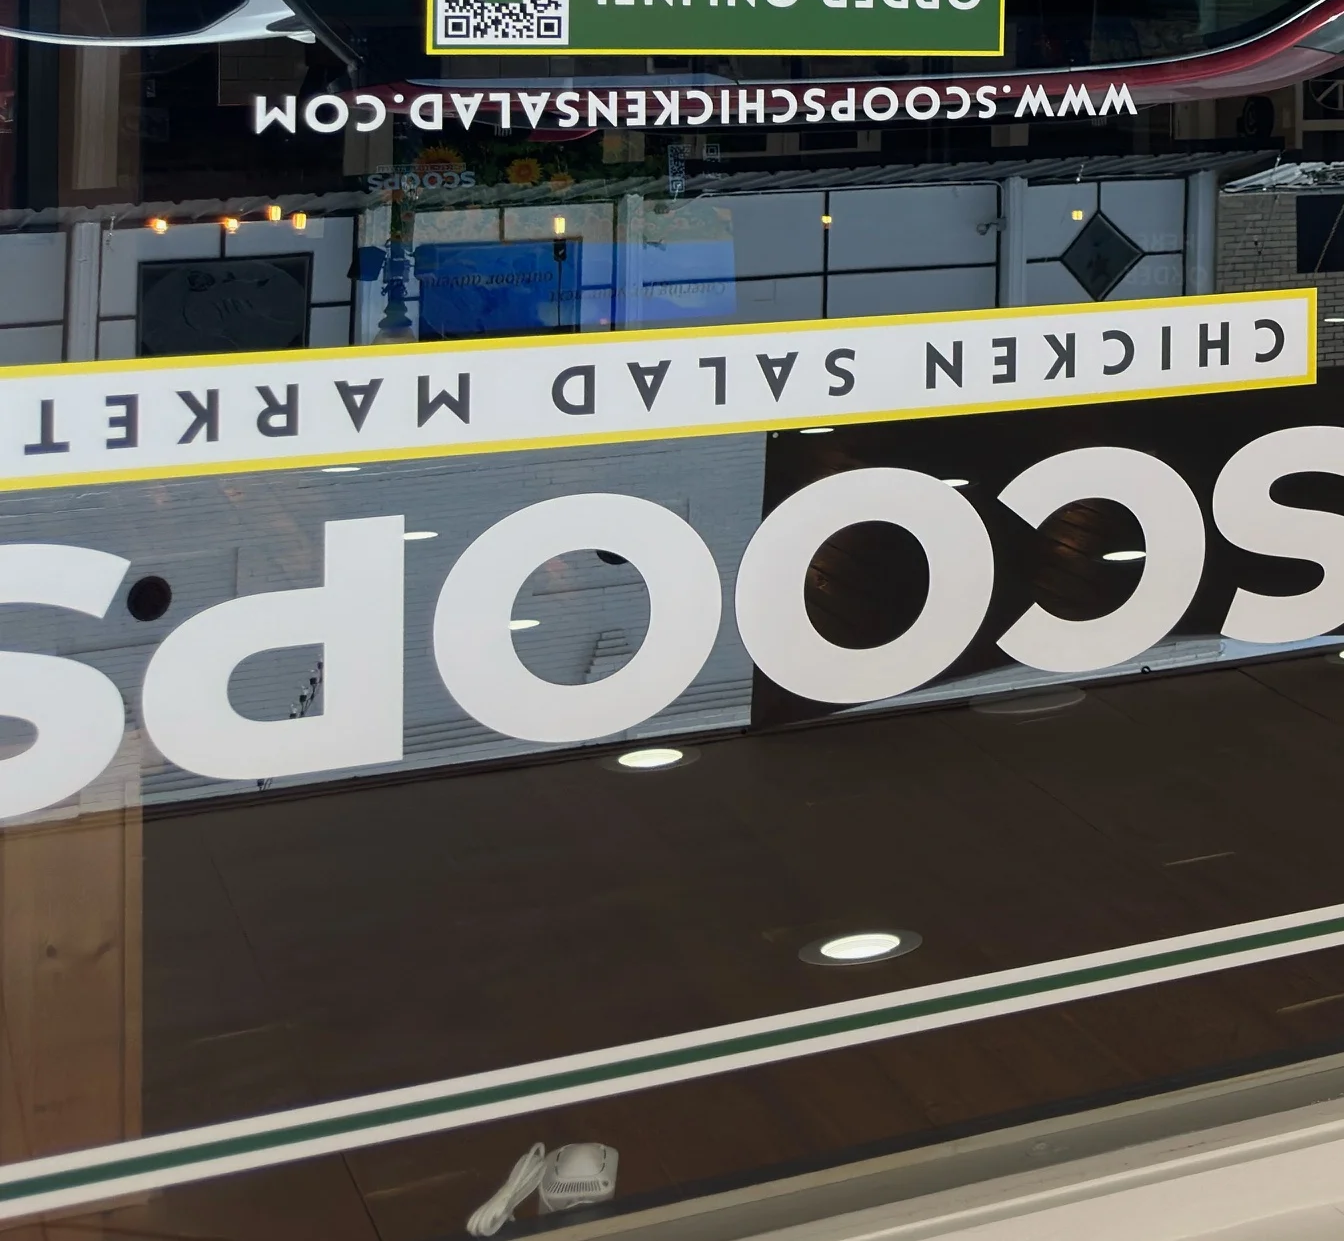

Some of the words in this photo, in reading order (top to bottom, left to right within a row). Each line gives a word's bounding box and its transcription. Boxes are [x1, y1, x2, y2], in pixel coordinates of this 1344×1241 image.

[251, 84, 1137, 134] WWW.SCOOPSCHICKENSALAD.COM
[367, 171, 476, 191] SCOOPS
[421, 273, 481, 291] adven
[551, 348, 856, 416] SALAD
[925, 318, 1285, 390] CHICKEN
[23, 372, 470, 455] MARKET
